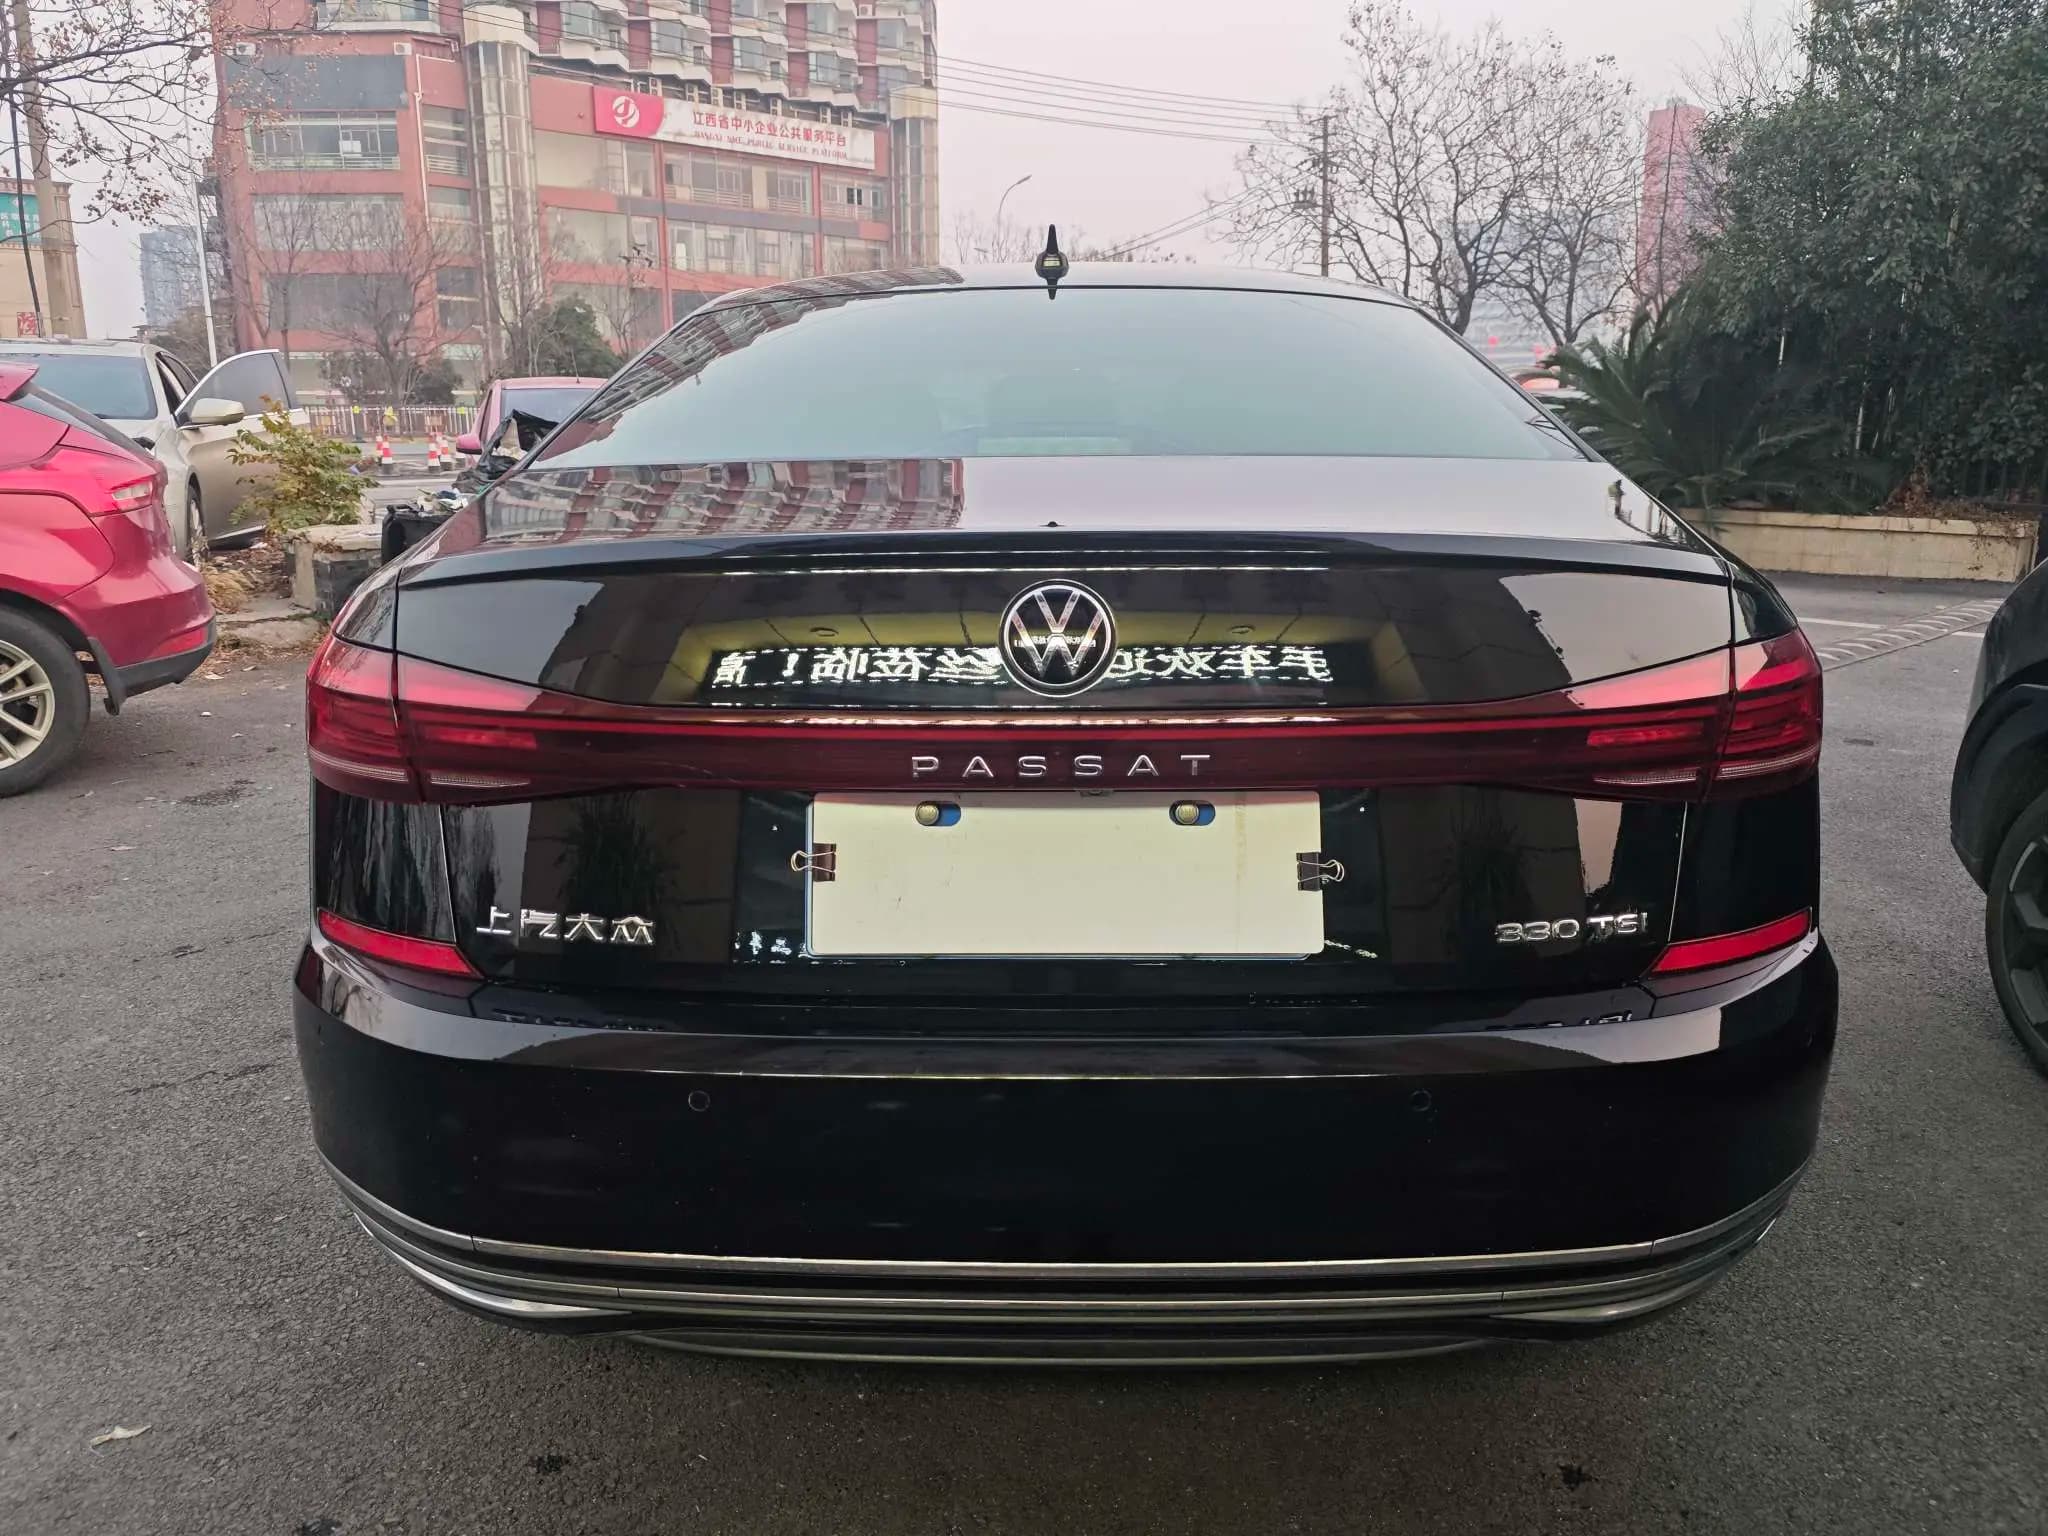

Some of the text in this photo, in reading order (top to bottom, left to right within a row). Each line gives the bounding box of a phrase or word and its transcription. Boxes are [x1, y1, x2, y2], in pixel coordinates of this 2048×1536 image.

[693, 111, 846, 146] 江西省中小企业公共服务平台
[911, 754, 1211, 778] PASSAT
[476, 906, 655, 945] 上汽大众
[1496, 912, 1648, 943] 330 TSI
